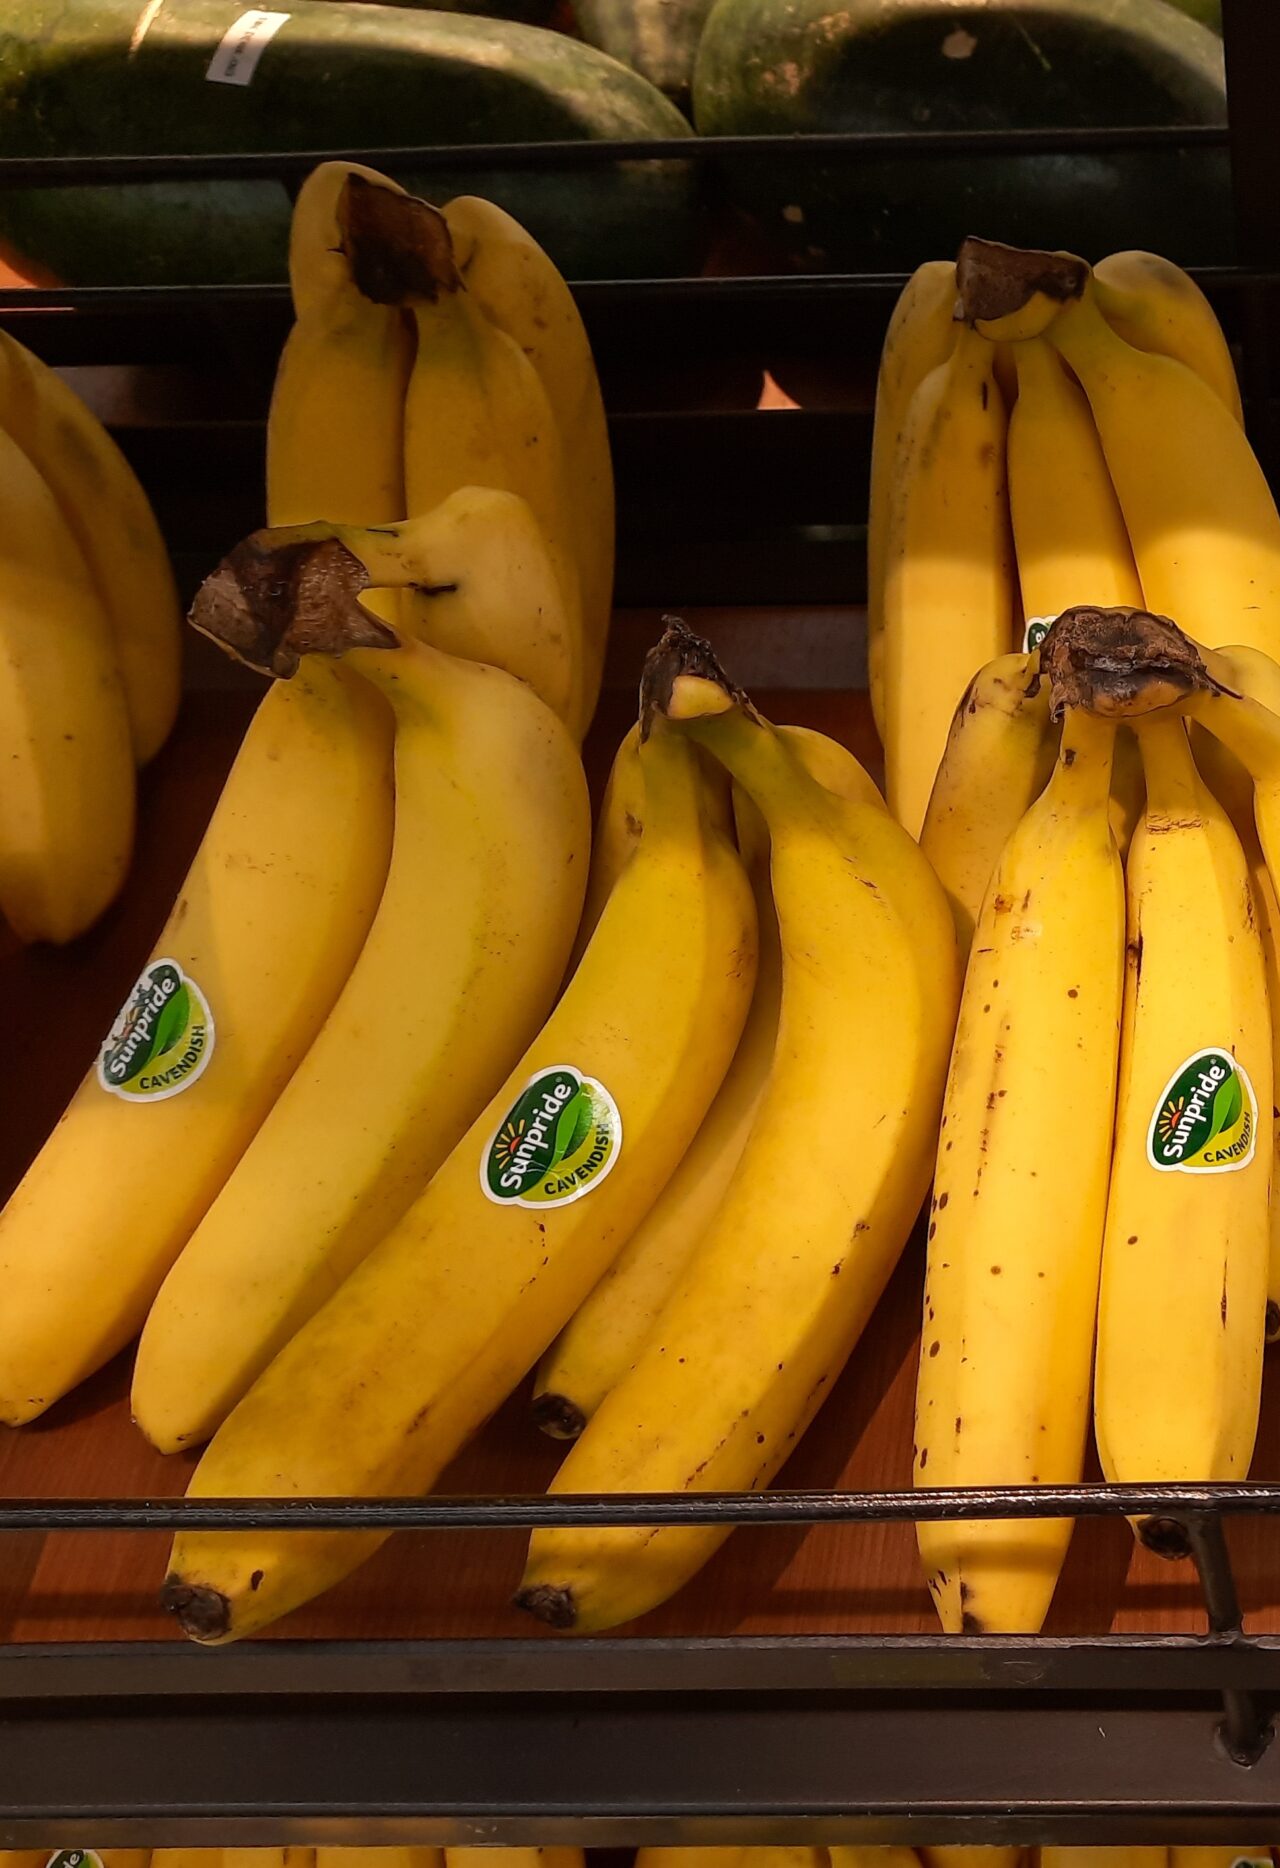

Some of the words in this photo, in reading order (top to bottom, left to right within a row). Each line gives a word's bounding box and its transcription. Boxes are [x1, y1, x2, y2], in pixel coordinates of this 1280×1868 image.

[109, 978, 176, 1078] Sunpride
[139, 1025, 205, 1089] CAVENDISH
[500, 1083, 572, 1190] Sunpride
[1163, 1065, 1225, 1158] Sunpride
[1203, 1111, 1251, 1163] CAVENDISH
[544, 1123, 609, 1195] CAVENDISH
